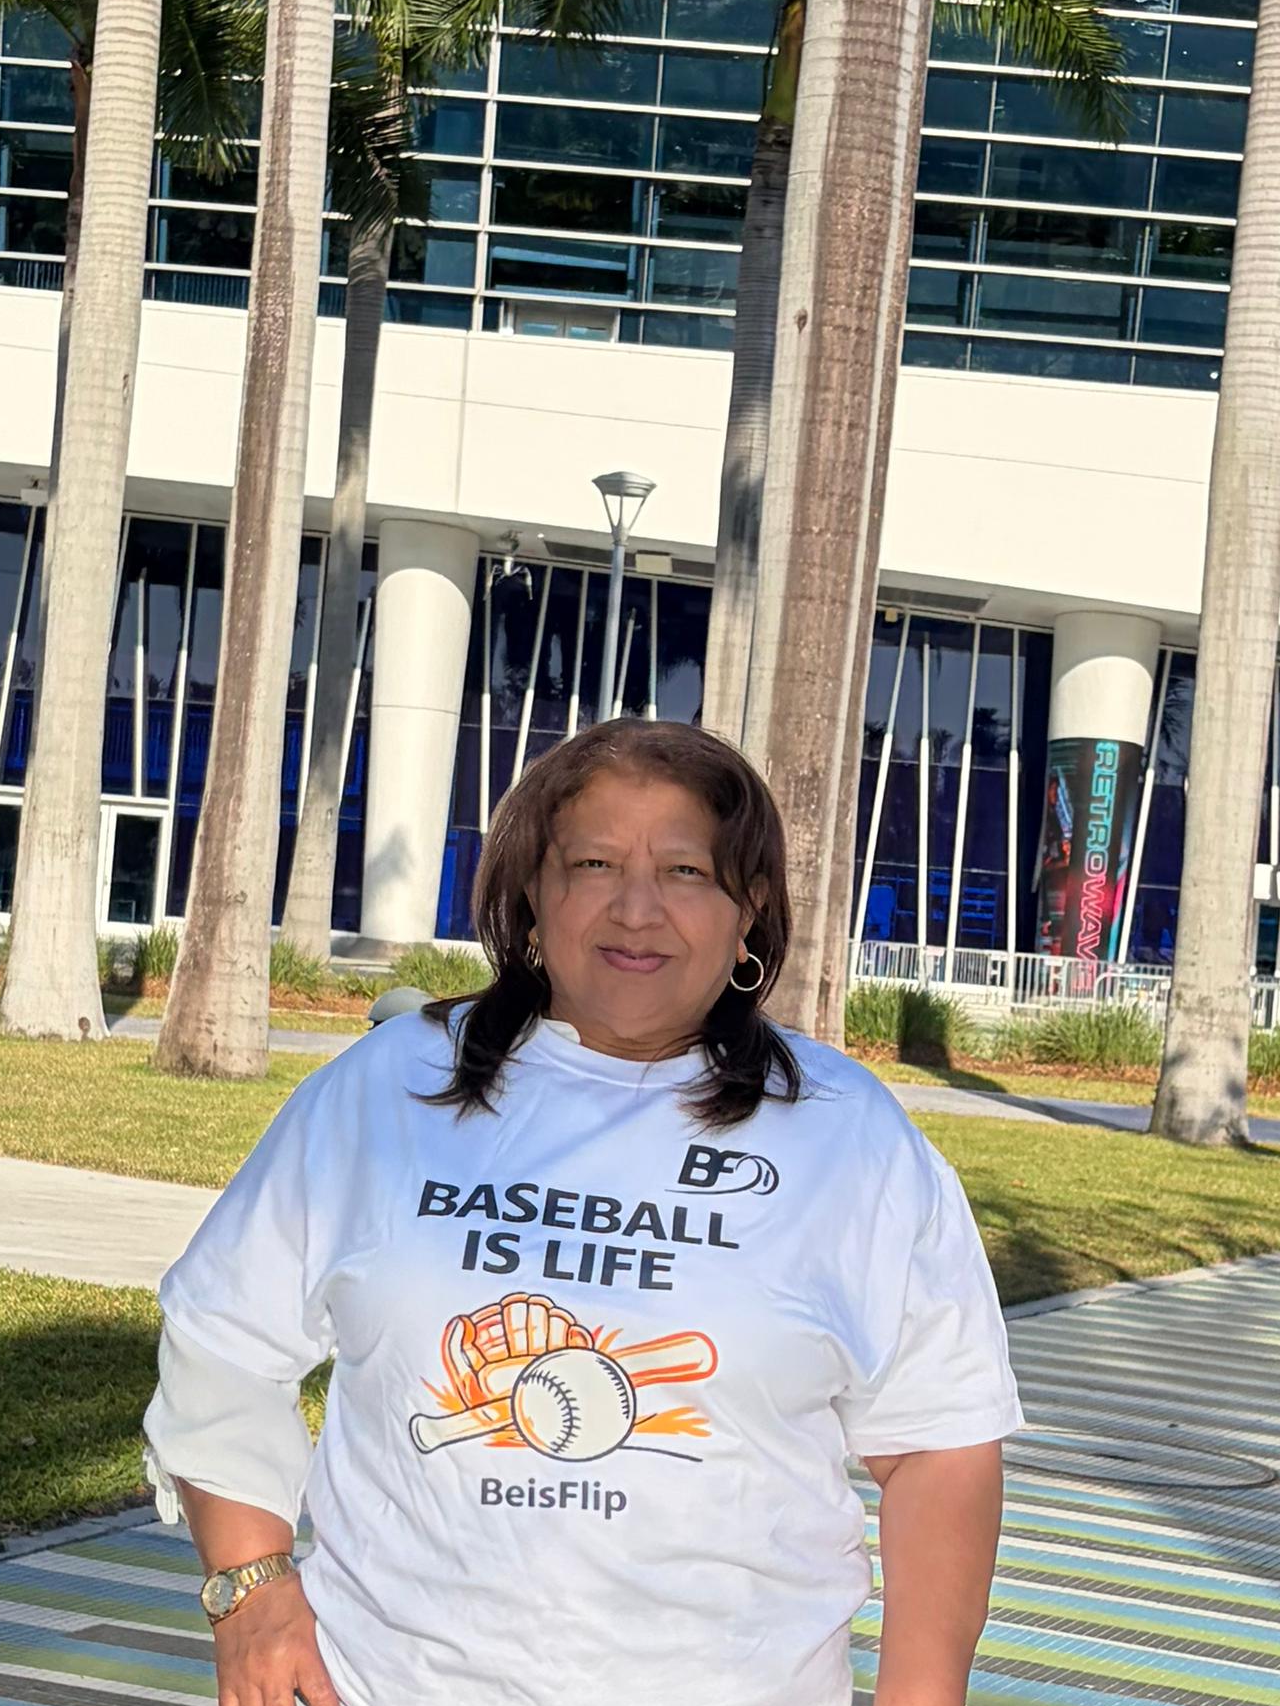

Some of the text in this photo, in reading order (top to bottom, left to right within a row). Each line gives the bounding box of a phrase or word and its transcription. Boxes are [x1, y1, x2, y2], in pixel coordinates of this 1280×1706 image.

[417, 1179, 740, 1250] BASEBALL
[461, 1229, 675, 1291] IS LIFE
[480, 1477, 628, 1520] BeisFlip
